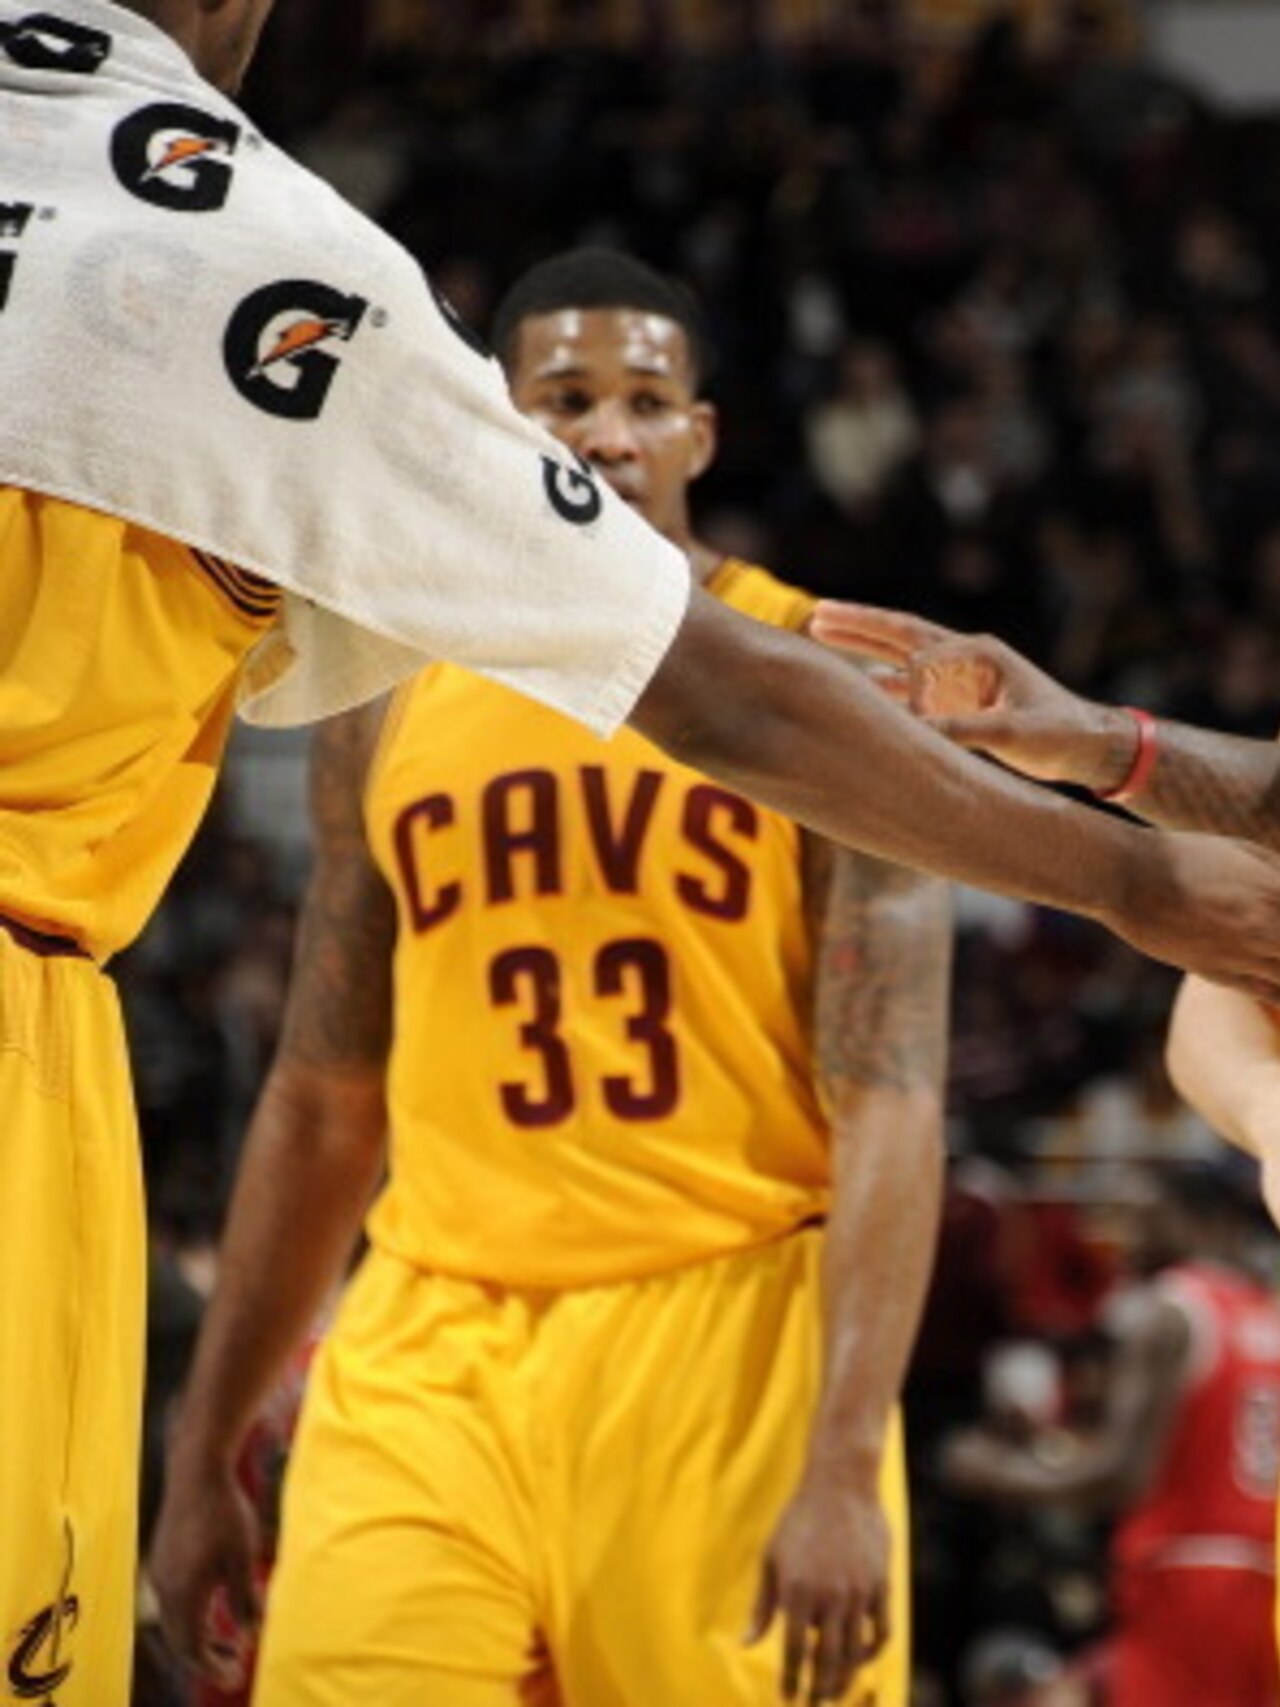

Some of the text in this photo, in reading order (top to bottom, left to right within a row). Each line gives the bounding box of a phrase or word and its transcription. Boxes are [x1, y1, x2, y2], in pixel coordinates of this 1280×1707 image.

[109, 102, 241, 213] G
[222, 279, 369, 421] G
[393, 765, 759, 936] CAVS
[488, 938, 680, 1130] 33
